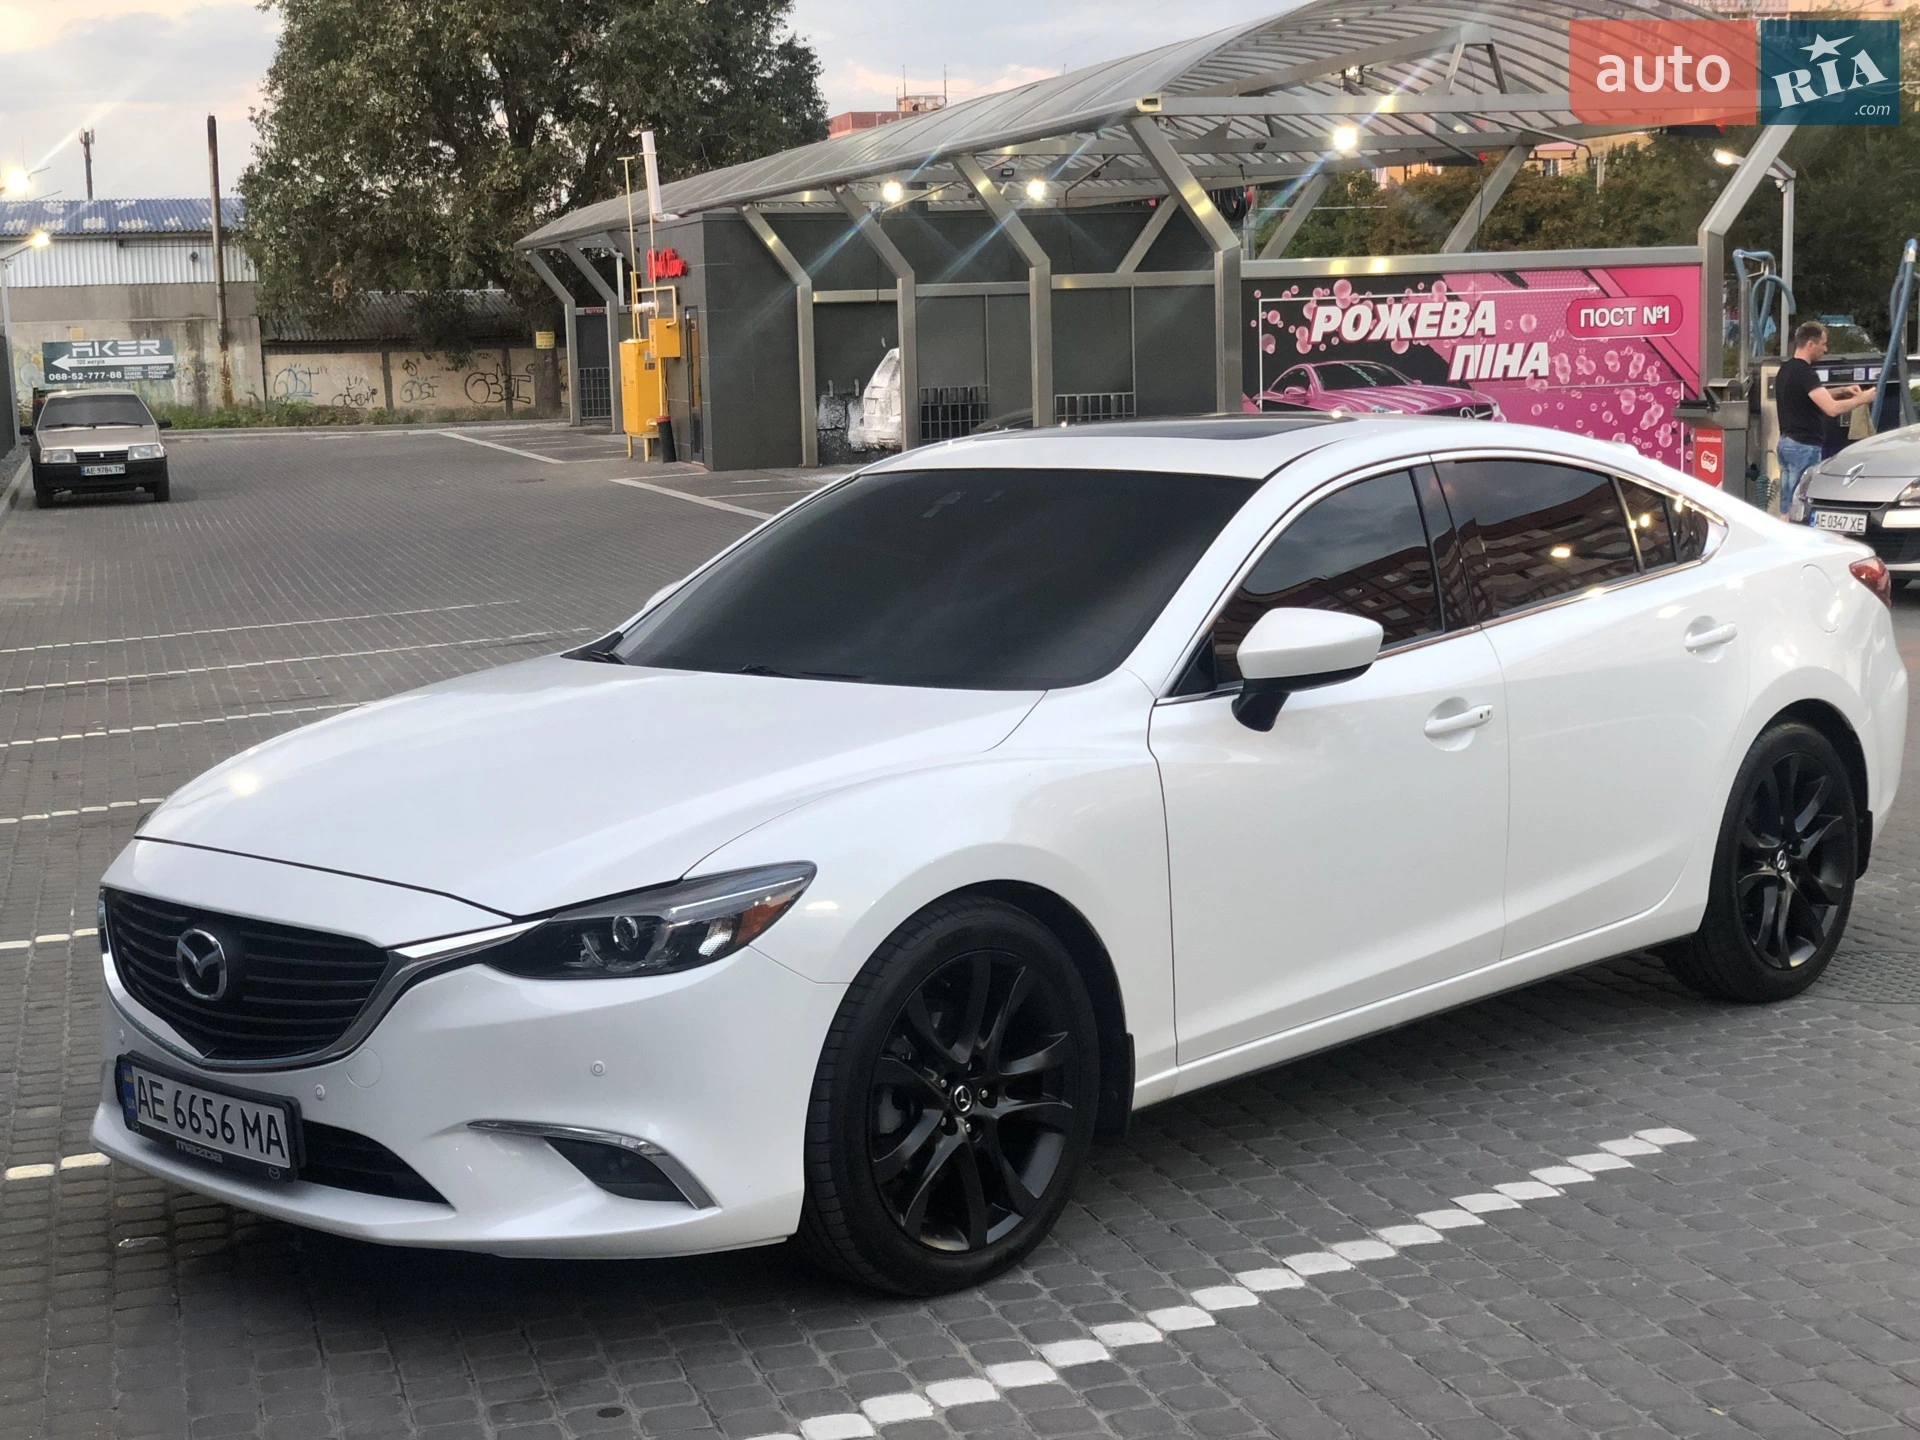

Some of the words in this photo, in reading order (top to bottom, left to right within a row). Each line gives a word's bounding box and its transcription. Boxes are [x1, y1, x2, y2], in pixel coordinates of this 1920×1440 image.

[1310, 300, 1497, 343] РОЖЕВА
[1578, 306, 1637, 328] ПОСТ
[48, 371, 123, 381] 068-52-777-88
[1447, 341, 1550, 381] ПІНА
[1815, 513, 1826, 528] AE
[1828, 515, 1848, 529] 0347
[1850, 517, 1864, 531] XE
[137, 1075, 168, 1124] AE
[173, 1089, 236, 1145] 6656
[240, 1107, 286, 1159] MA
